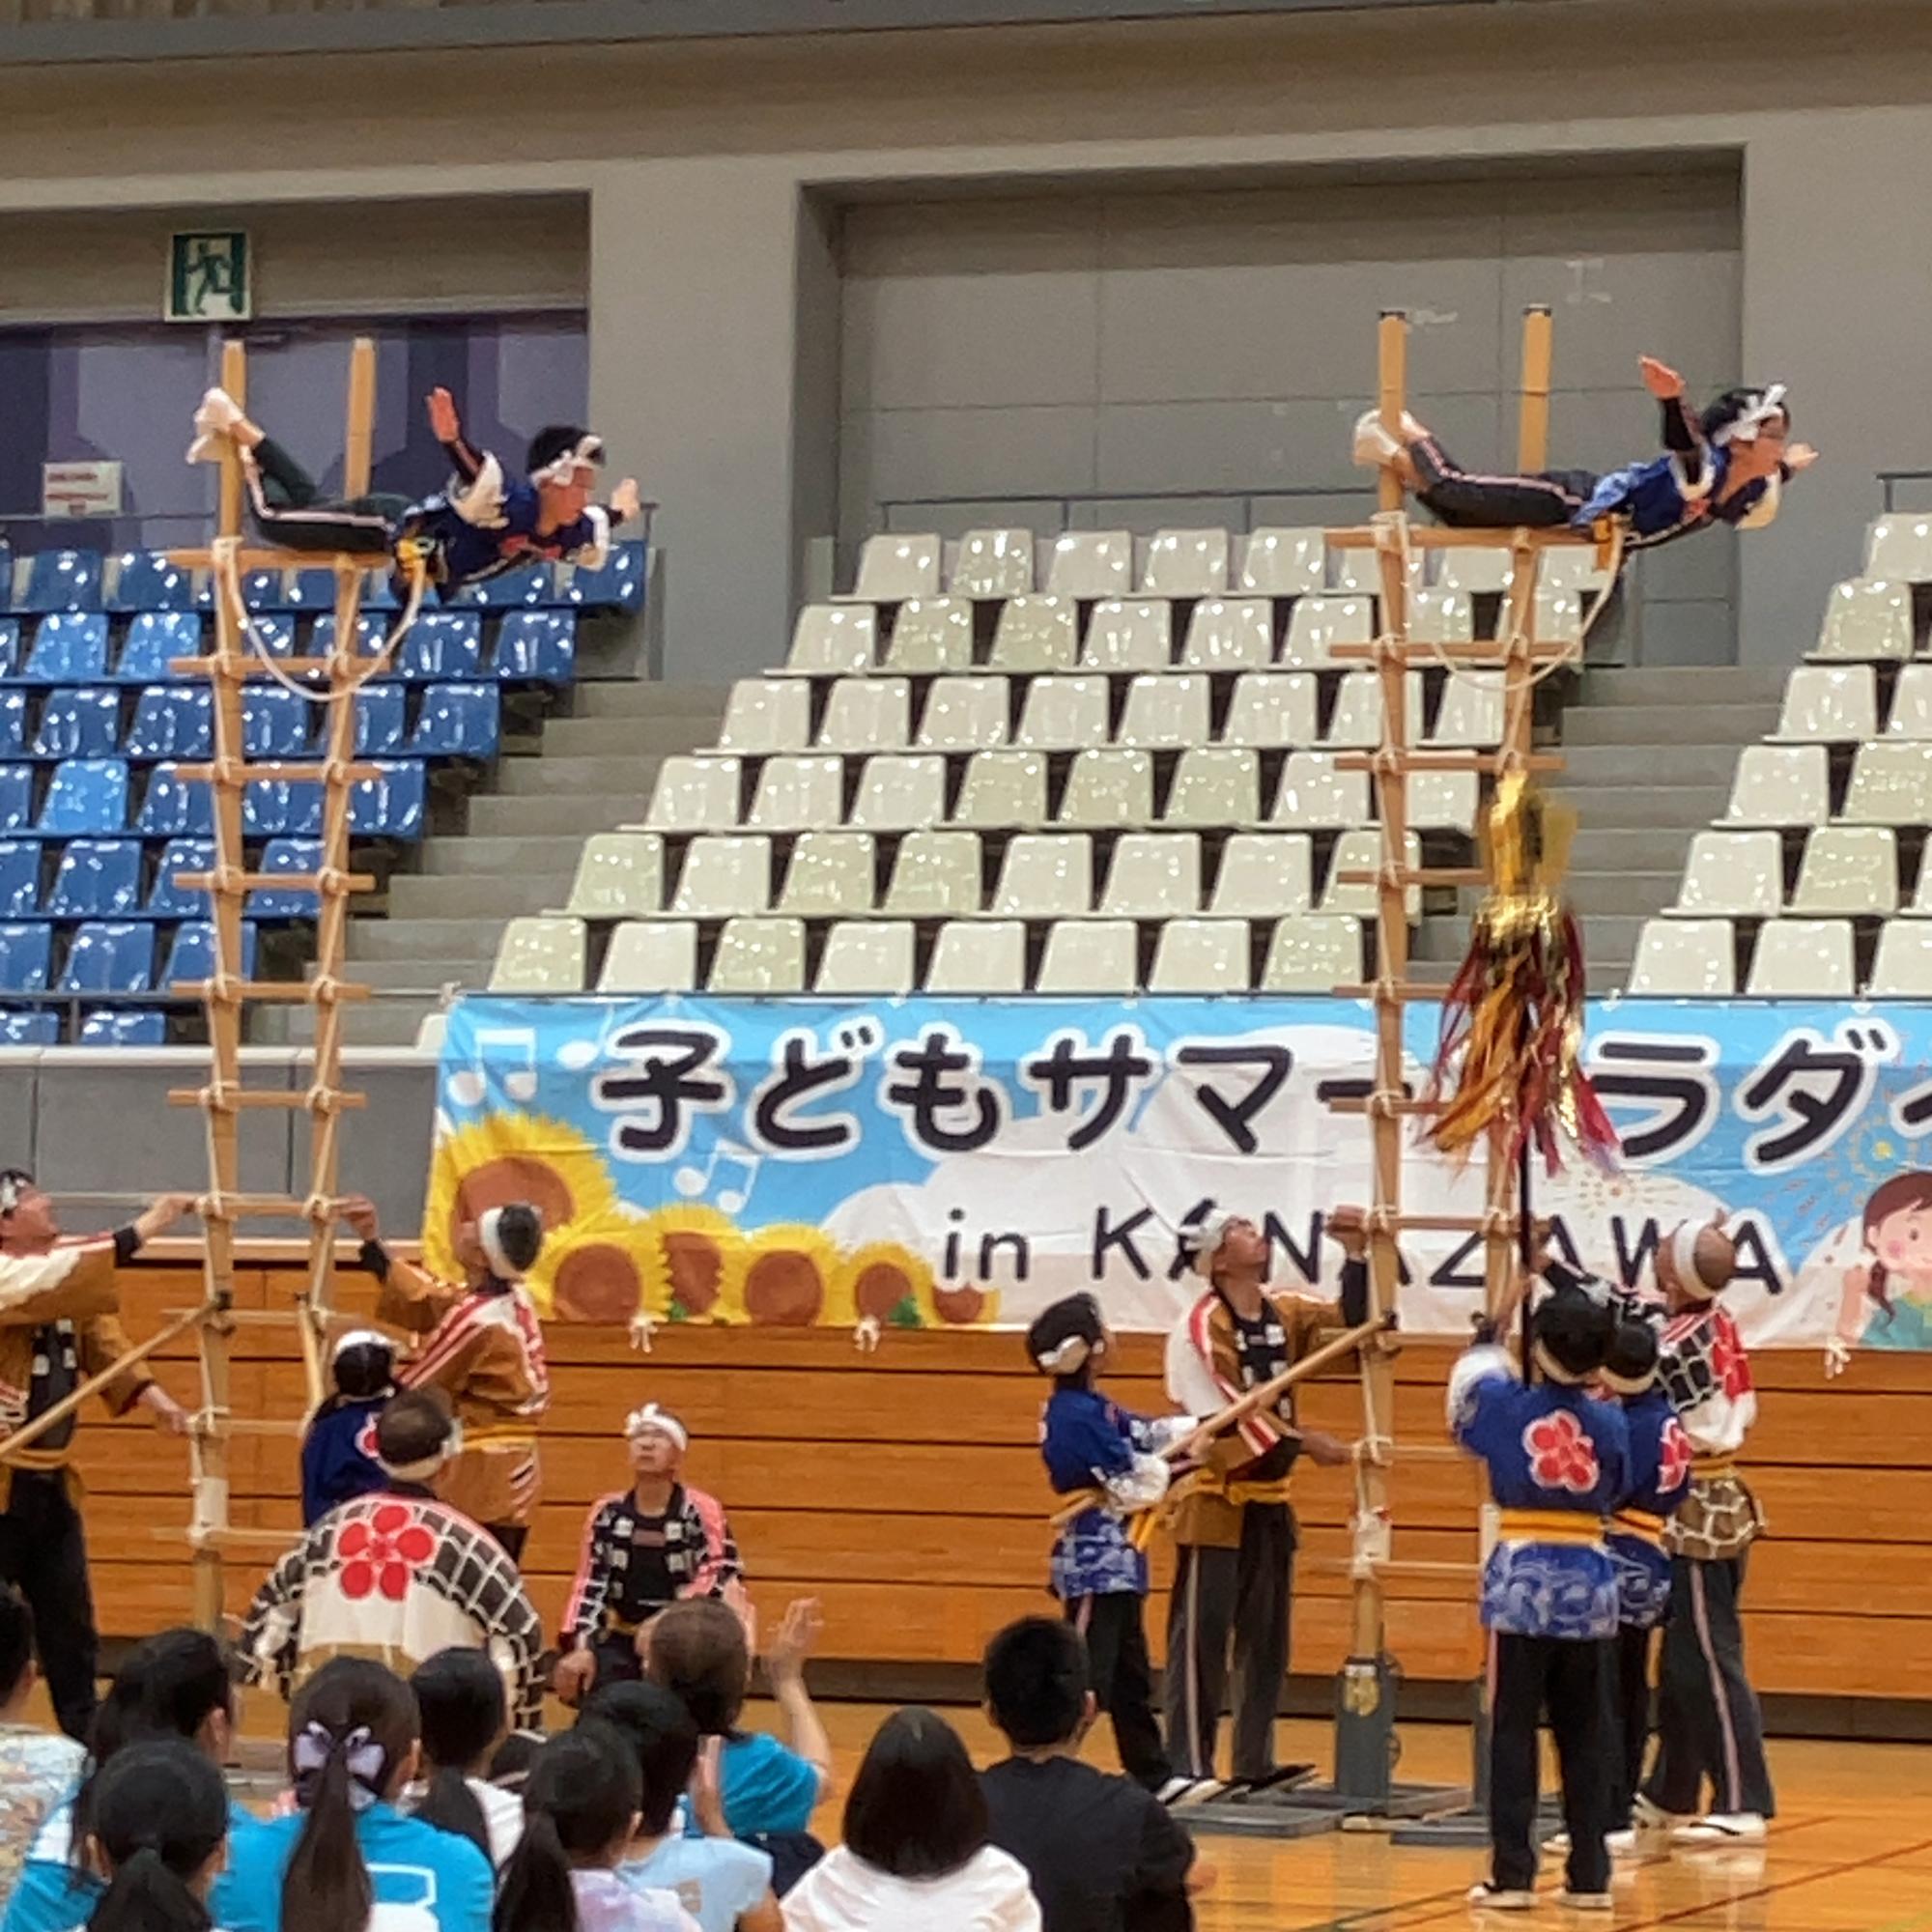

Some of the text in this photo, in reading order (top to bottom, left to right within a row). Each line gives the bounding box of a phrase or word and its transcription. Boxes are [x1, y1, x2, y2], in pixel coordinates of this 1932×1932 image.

[600, 1025, 1932, 1161] 子どもサマーラダ
[943, 1203, 1782, 1294] in KNZWA
